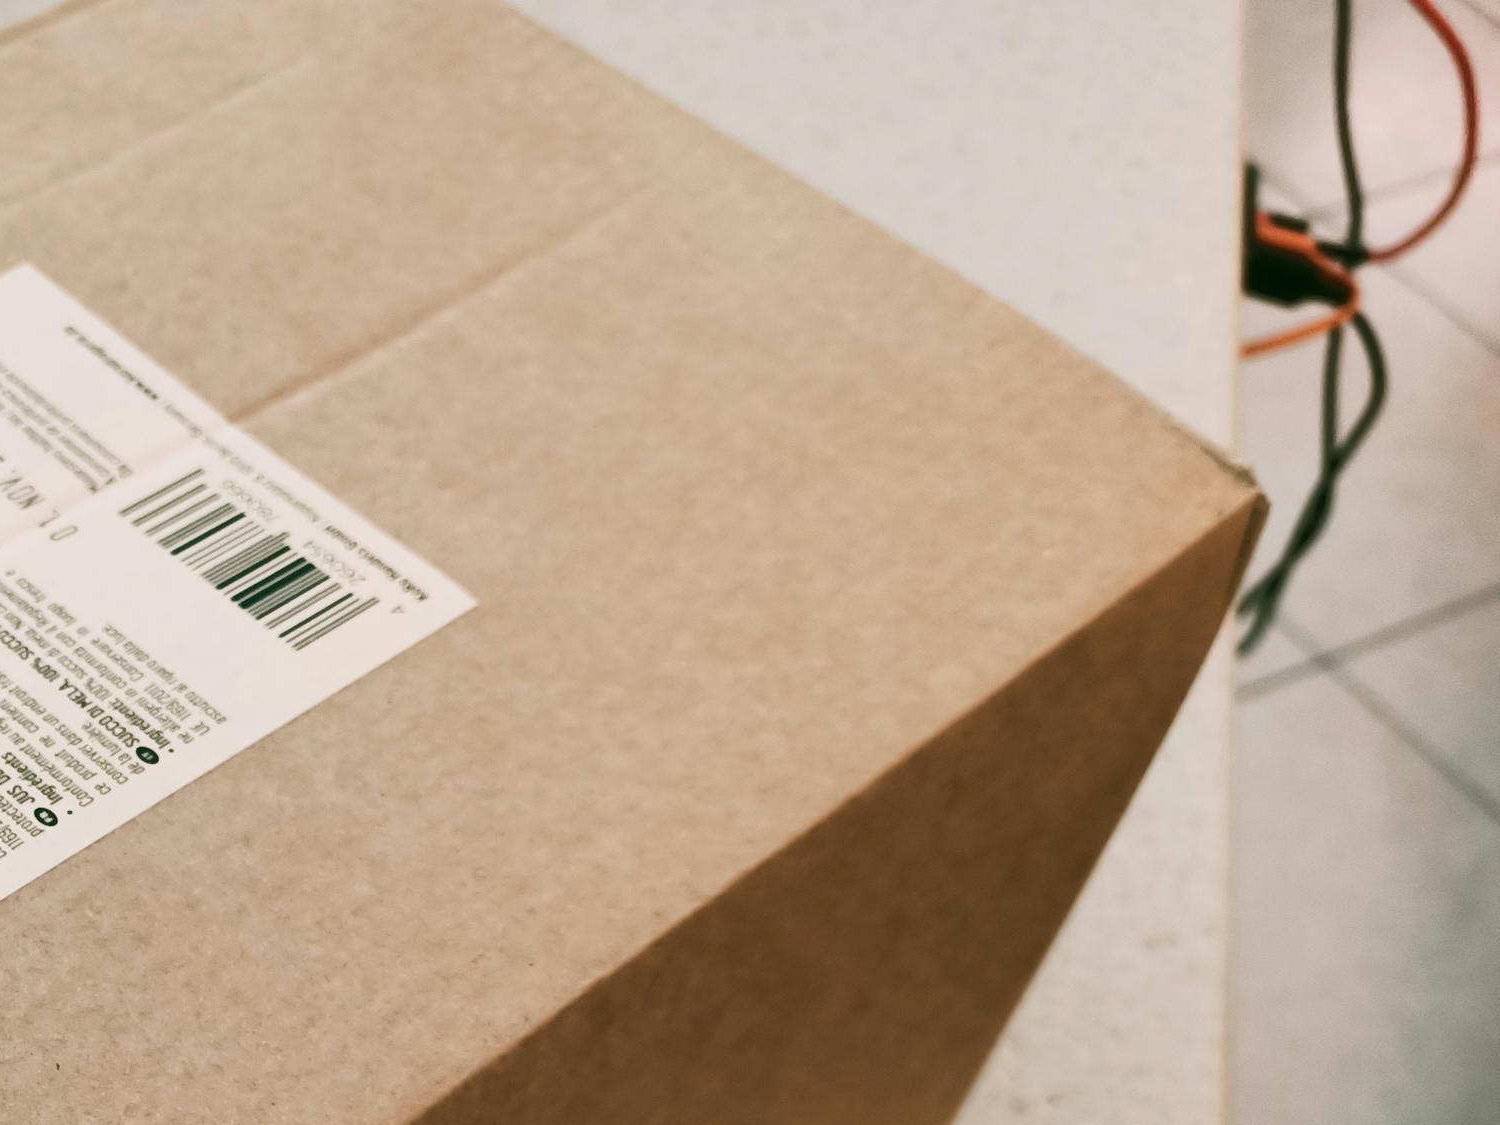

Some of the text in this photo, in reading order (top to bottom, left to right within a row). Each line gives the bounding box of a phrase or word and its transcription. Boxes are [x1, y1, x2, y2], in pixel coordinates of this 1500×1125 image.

[6, 684, 47, 716] endroit
[40, 712, 60, 727] un
[85, 703, 106, 719] DI
[53, 722, 84, 747] dans
[97, 714, 141, 749] SUCCO
[188, 720, 211, 737] UE
[8, 731, 26, 746] au
[37, 734, 56, 749] ne
[176, 730, 194, 745] ne
[52, 747, 98, 781] produit
[77, 743, 129, 785] conserver
[116, 751, 133, 766] la
[18, 742, 95, 808] Conformément
[126, 760, 146, 775] de
[0, 750, 64, 806] Ingrédients
[5, 783, 36, 805] JUS
[93, 781, 112, 796] ce
